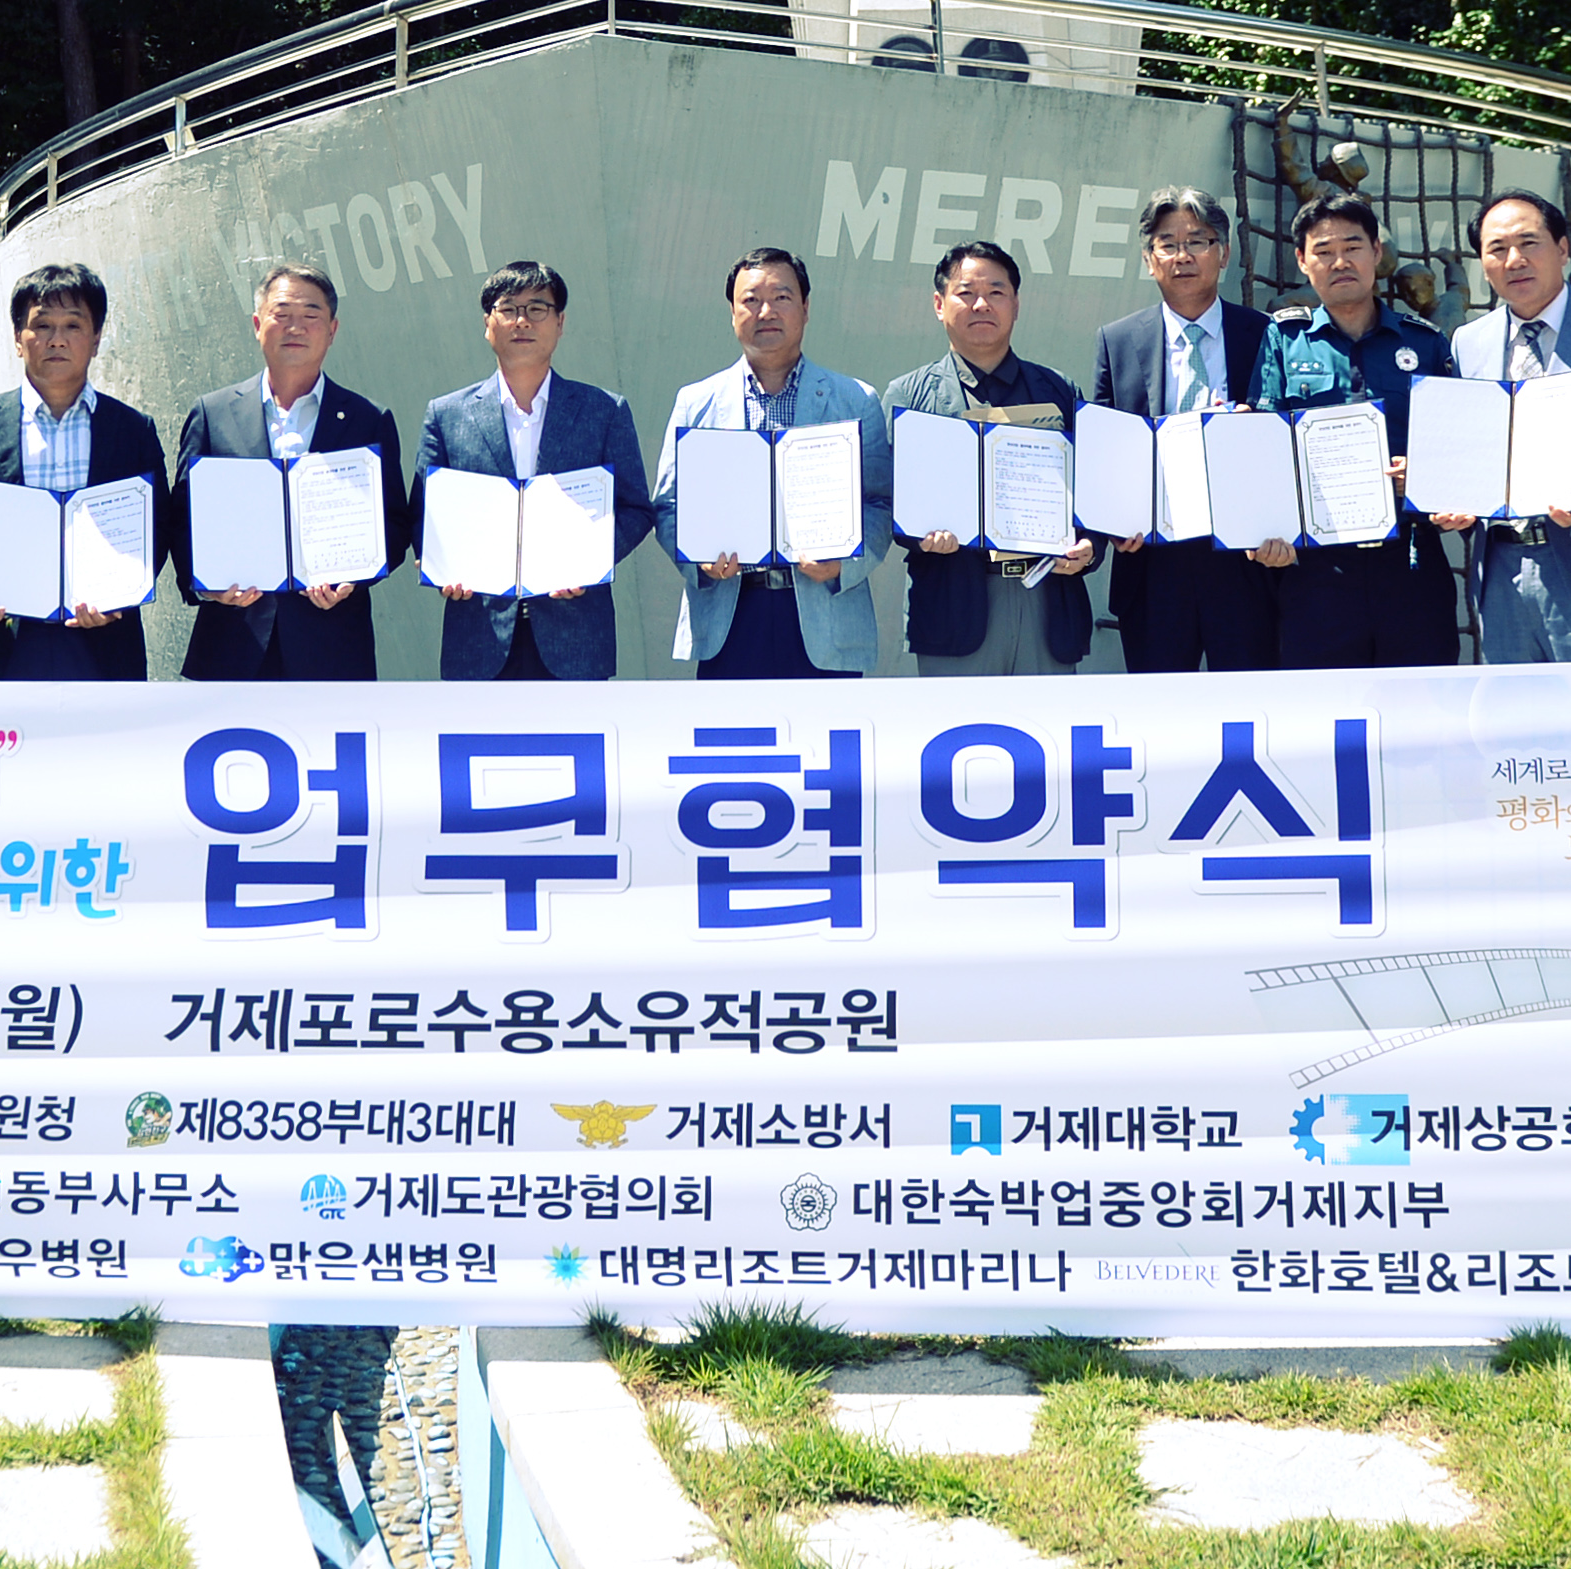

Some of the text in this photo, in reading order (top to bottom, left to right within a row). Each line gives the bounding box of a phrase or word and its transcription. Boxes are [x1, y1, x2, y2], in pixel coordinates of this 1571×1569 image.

[183, 719, 1373, 932] 업무협약식
[163, 987, 899, 1055] 거제포로수용소유적공원
[174, 1096, 517, 1147] 제8358부대3대대
[665, 1101, 891, 1150] 거제소방서
[1010, 1105, 1243, 1153] 거제대학교
[352, 1172, 712, 1222] 거제도관광협의회
[852, 1178, 1450, 1230] 대한숙박업중앙회거제지부
[269, 1240, 498, 1284] 맑은샘병원
[599, 1244, 1073, 1293] 대명리조트거제마리나
[1094, 1258, 1221, 1289] BELVEDERE
